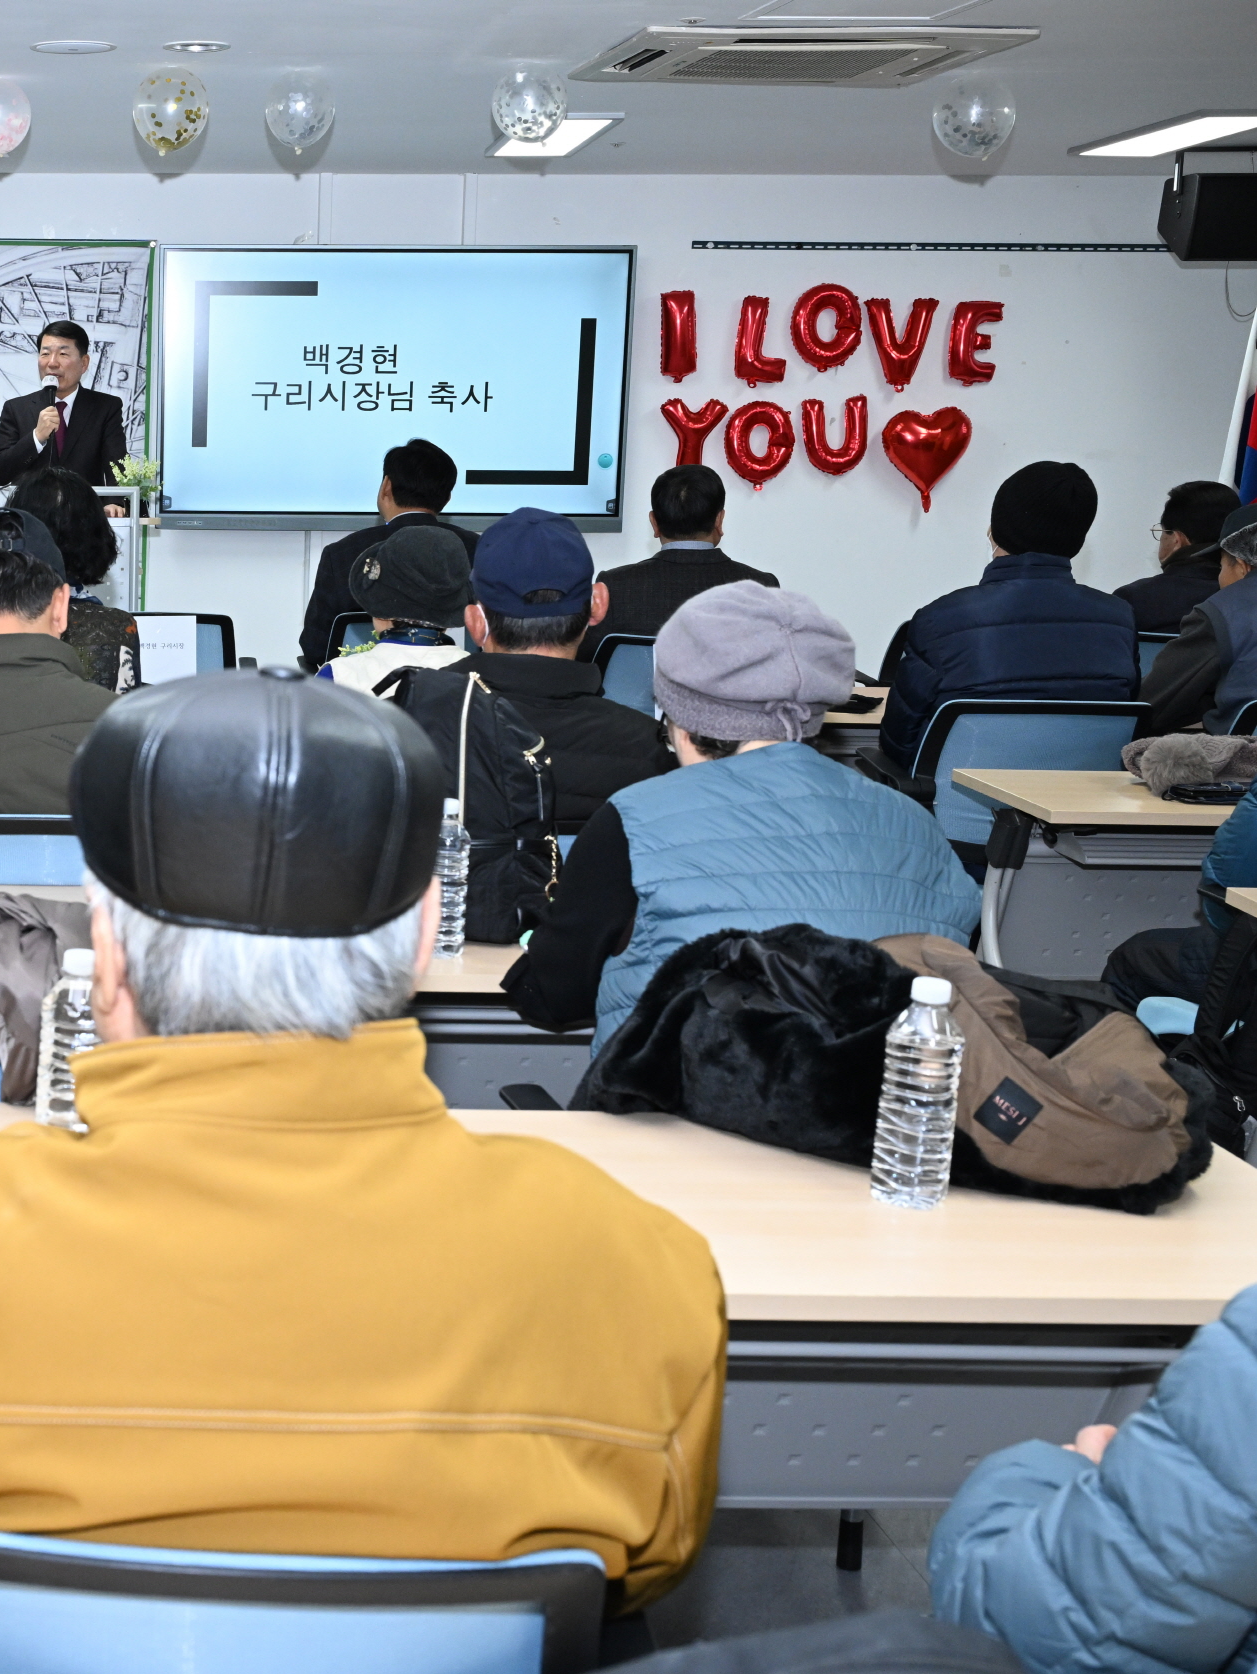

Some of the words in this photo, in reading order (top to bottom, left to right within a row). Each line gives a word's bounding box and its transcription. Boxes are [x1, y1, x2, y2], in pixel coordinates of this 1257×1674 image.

[660, 290, 697, 383] I
[734, 283, 1005, 392] LOVE
[303, 344, 398, 375] 백경현
[251, 380, 414, 412] 구리시장님
[428, 381, 493, 413] 축사
[660, 394, 868, 491] YOU
[993, 1095, 1020, 1119] MESI
